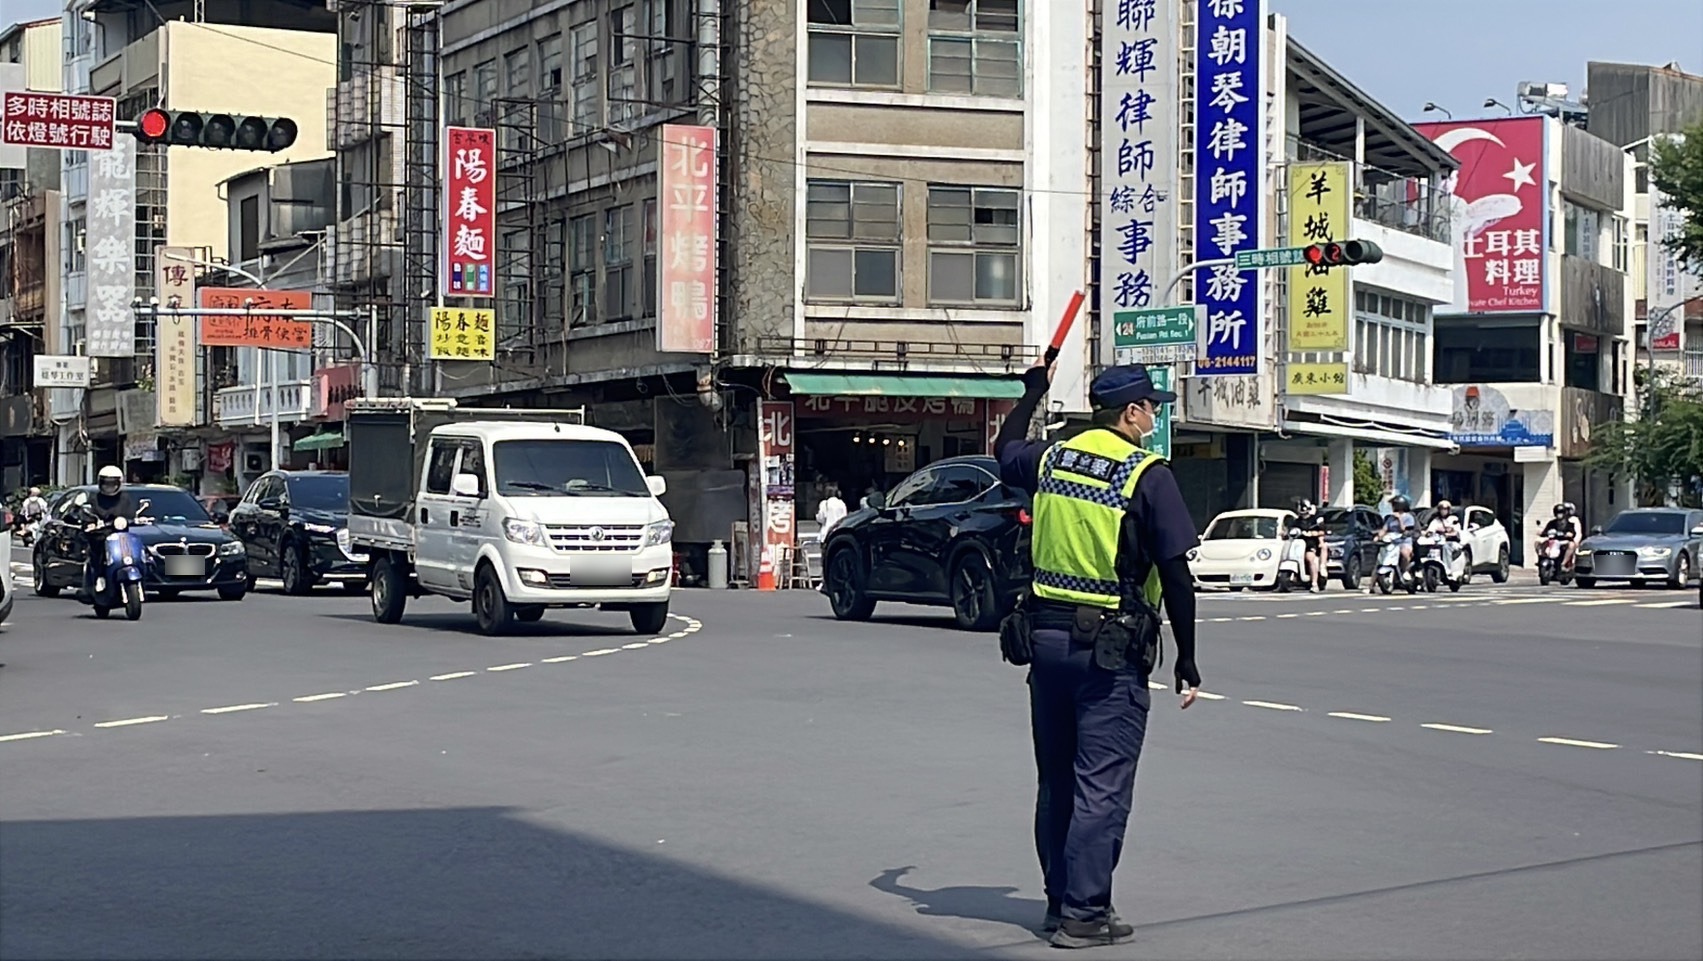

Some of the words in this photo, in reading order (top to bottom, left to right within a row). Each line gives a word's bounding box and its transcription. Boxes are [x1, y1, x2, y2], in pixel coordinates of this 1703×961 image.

[7, 96, 112, 122] 多時相號誌
[6, 120, 111, 147] 依燈號行駛
[454, 148, 488, 260] 陽春麵
[670, 136, 709, 321] 北平烤鴨
[1463, 228, 1541, 258] 土耳其
[1485, 258, 1541, 286] 料理
[1502, 286, 1539, 298] Turkey
[243, 326, 308, 342] 排骨便當
[436, 311, 490, 332] 陽春麵
[1198, 355, 1256, 369] 06-2144117
[1291, 371, 1345, 385] 廣東小館
[1060, 449, 1111, 477] 警察
